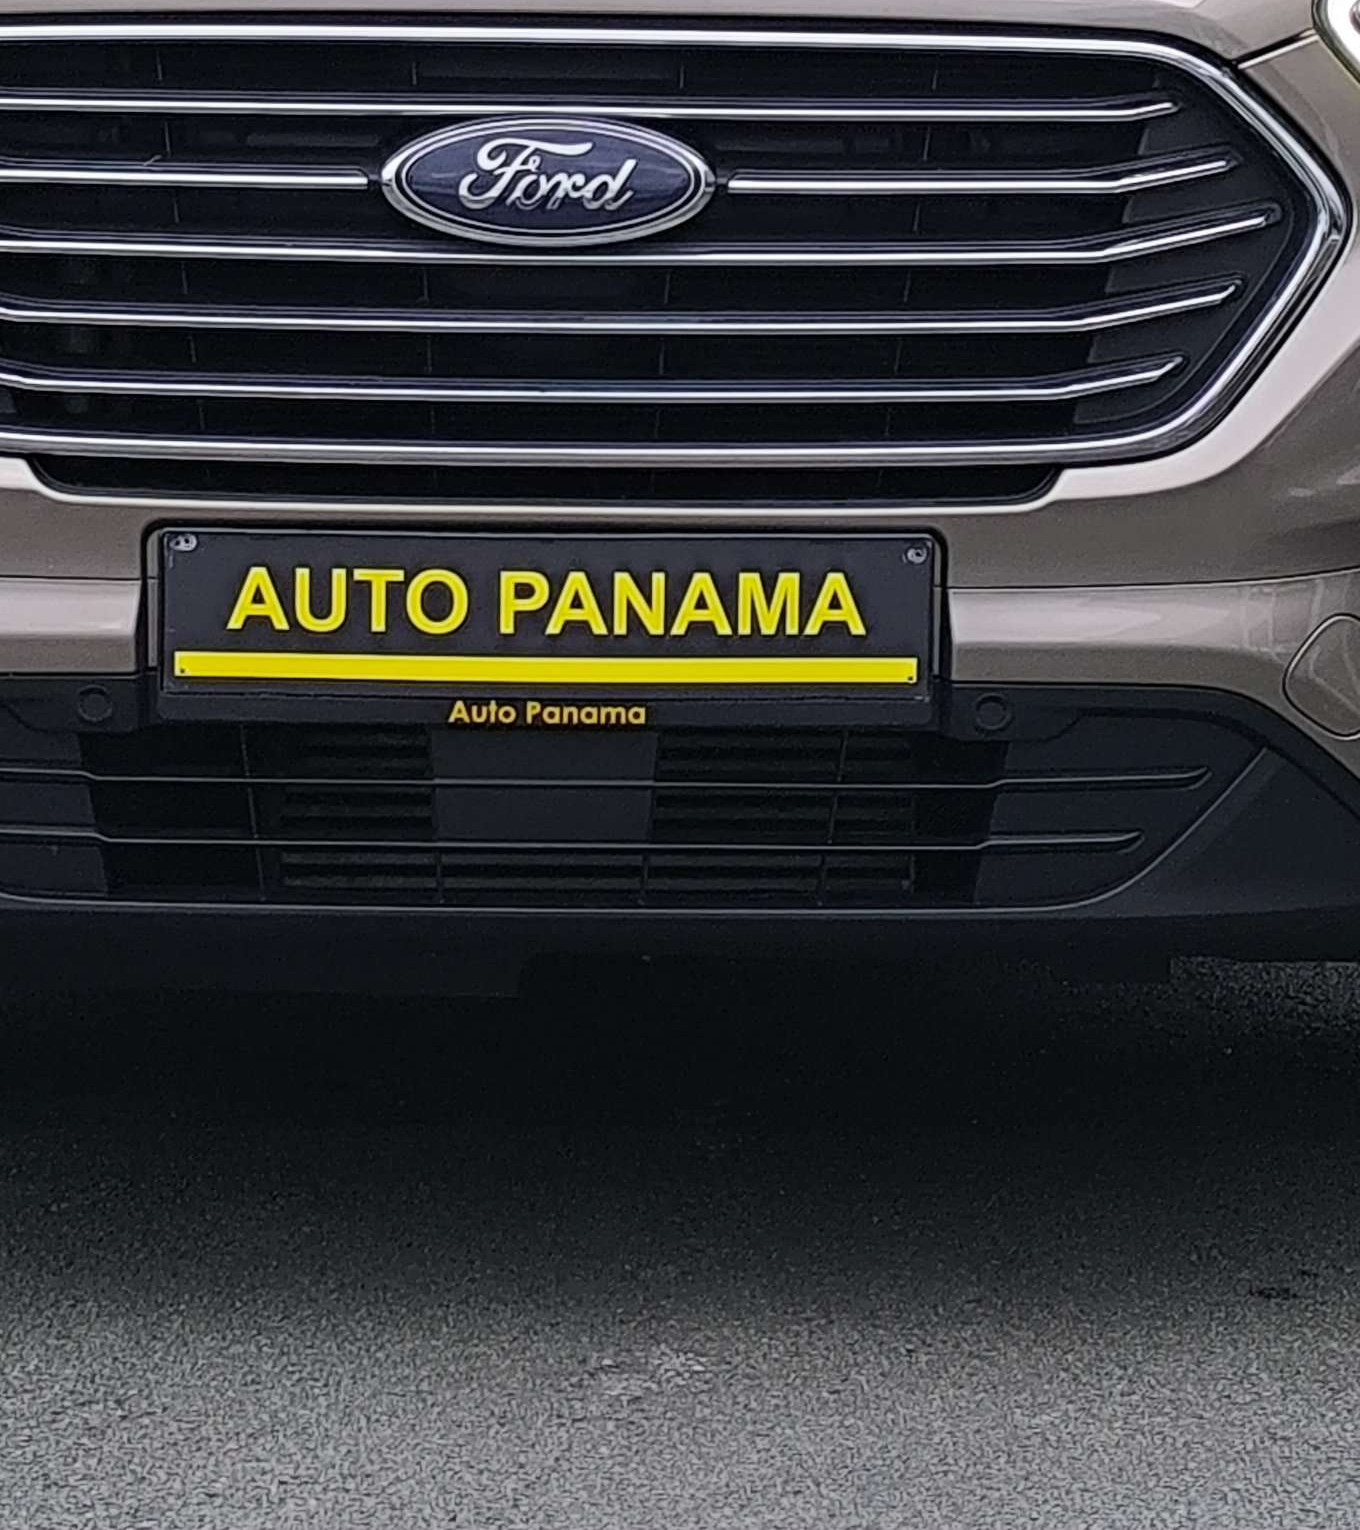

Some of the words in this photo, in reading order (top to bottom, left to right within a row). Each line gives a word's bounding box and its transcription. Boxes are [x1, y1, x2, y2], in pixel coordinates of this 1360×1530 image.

[458, 137, 638, 211] Ford
[225, 566, 469, 635] AUTO
[499, 570, 867, 636] PANAMA
[448, 699, 517, 724] Auto
[526, 700, 646, 725] Panama
